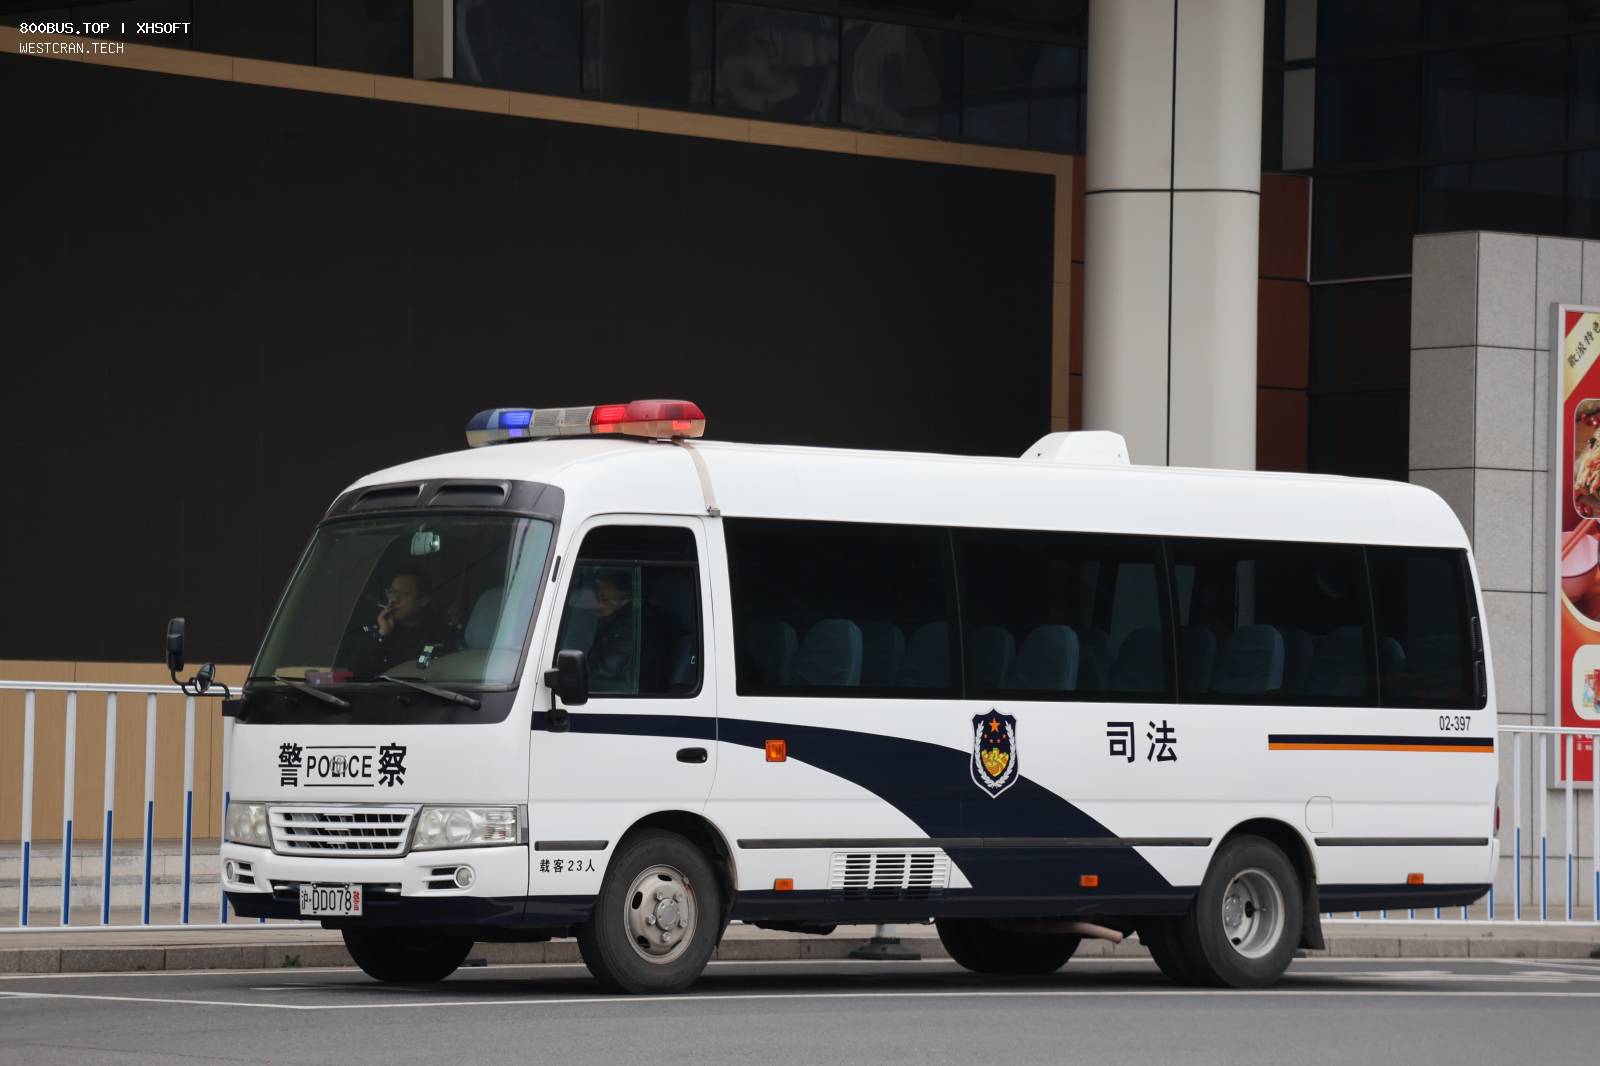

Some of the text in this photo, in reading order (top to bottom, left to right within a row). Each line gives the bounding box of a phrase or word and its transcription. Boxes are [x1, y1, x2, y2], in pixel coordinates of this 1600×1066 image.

[1439, 715, 1471, 731] 02-397
[1106, 719, 1178, 763] 司法
[278, 742, 407, 787] 警 POLICE 察
[539, 858, 596, 873] 载客23人
